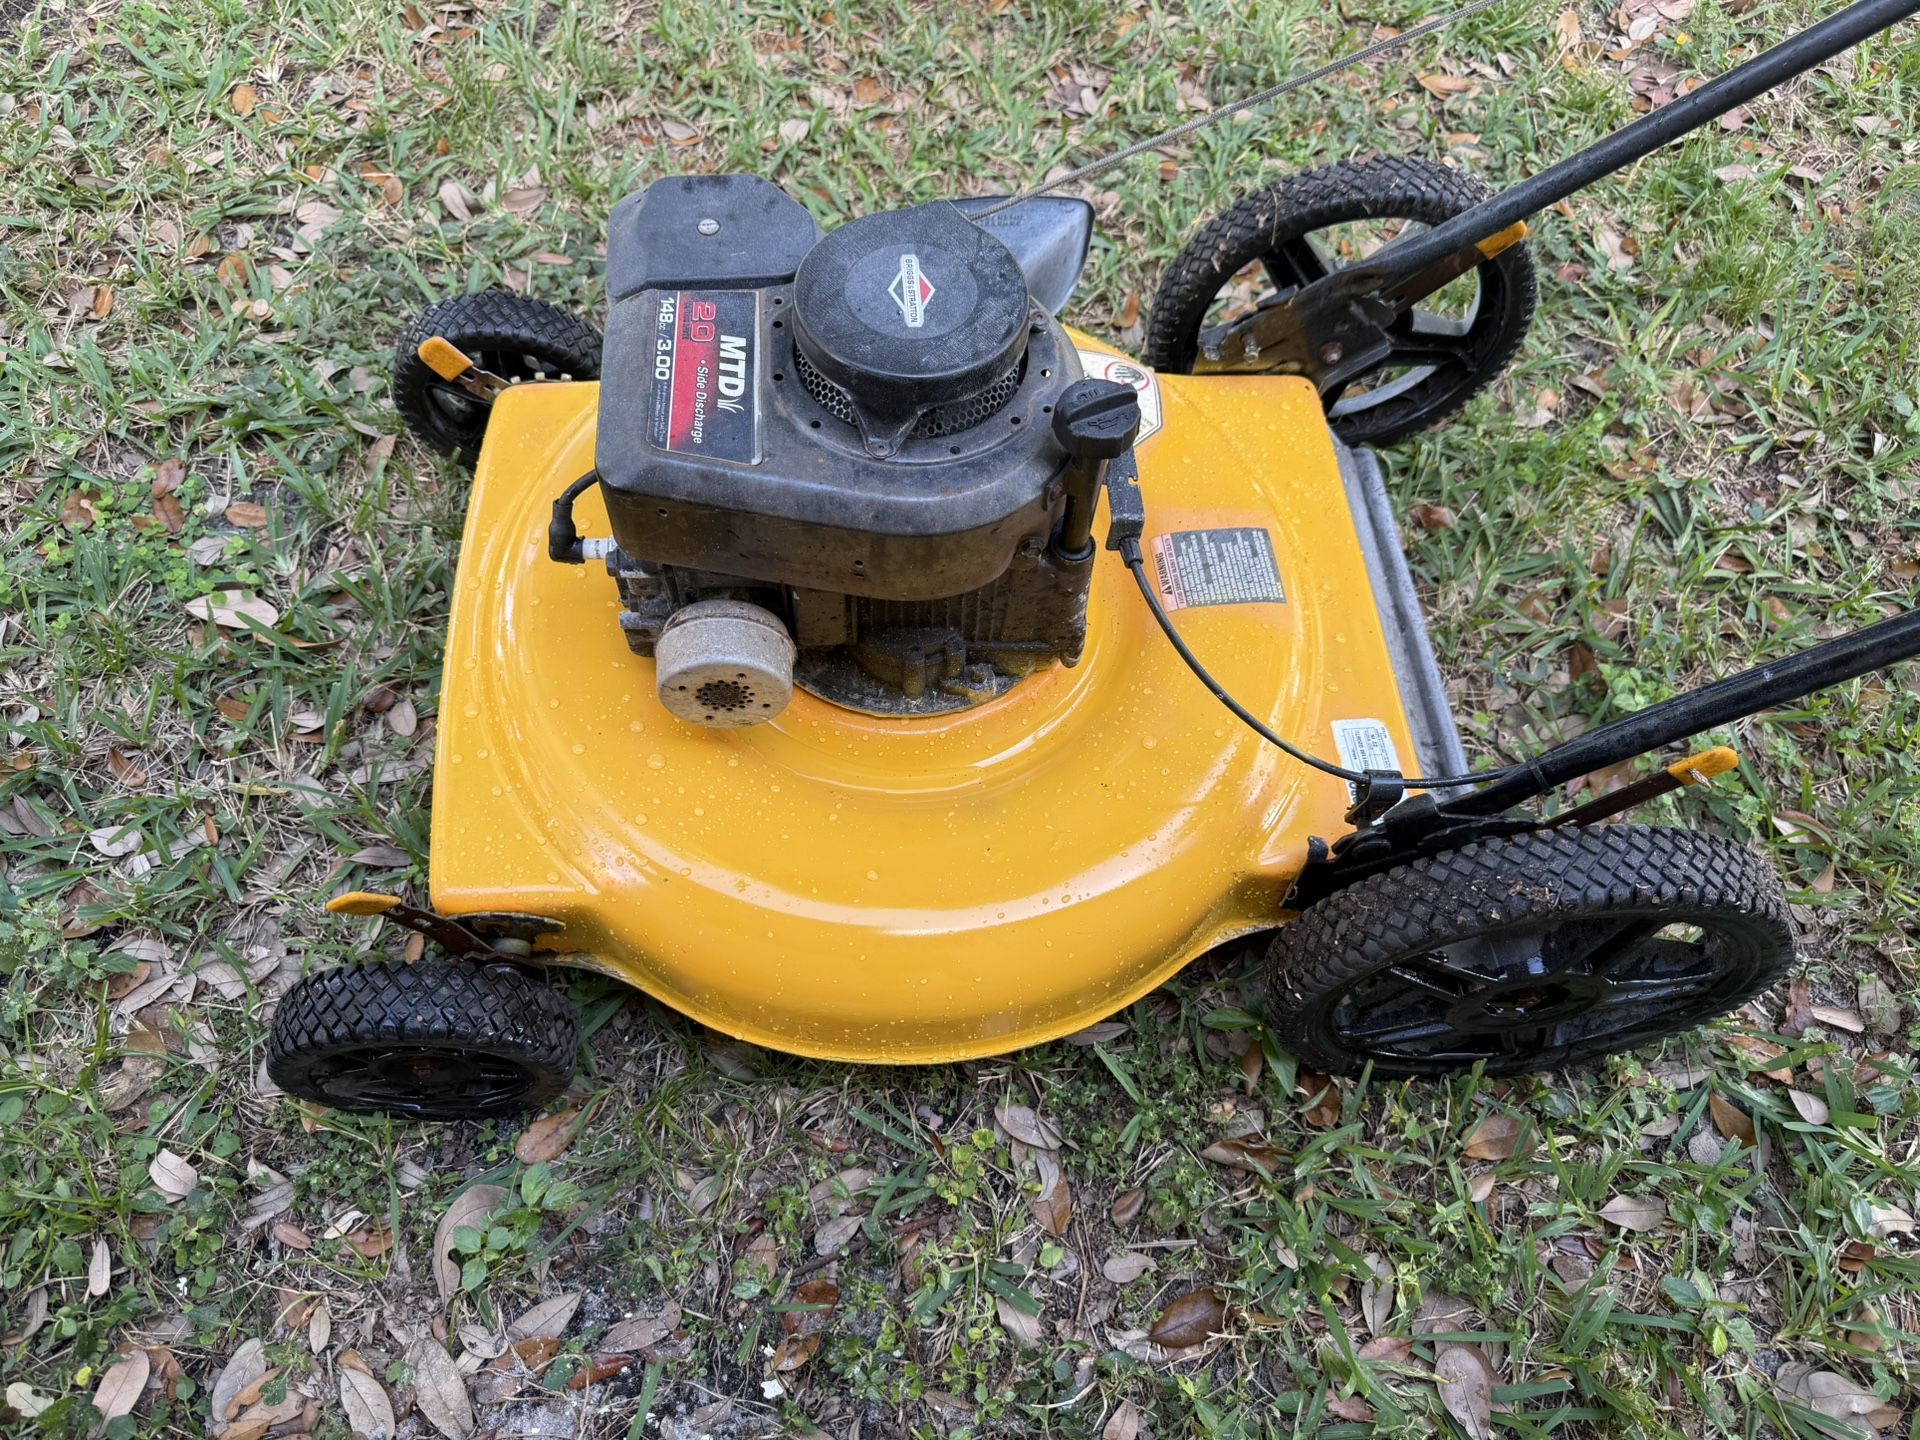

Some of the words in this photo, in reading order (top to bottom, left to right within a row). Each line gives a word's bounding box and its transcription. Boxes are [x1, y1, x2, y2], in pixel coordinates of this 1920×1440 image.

[690, 301, 717, 342] 20
[655, 339, 672, 380] 3.00
[696, 366, 709, 389] Side
[718, 334, 747, 397] MTD
[690, 389, 708, 444] Discharge
[1155, 552, 1170, 587] WARNING
